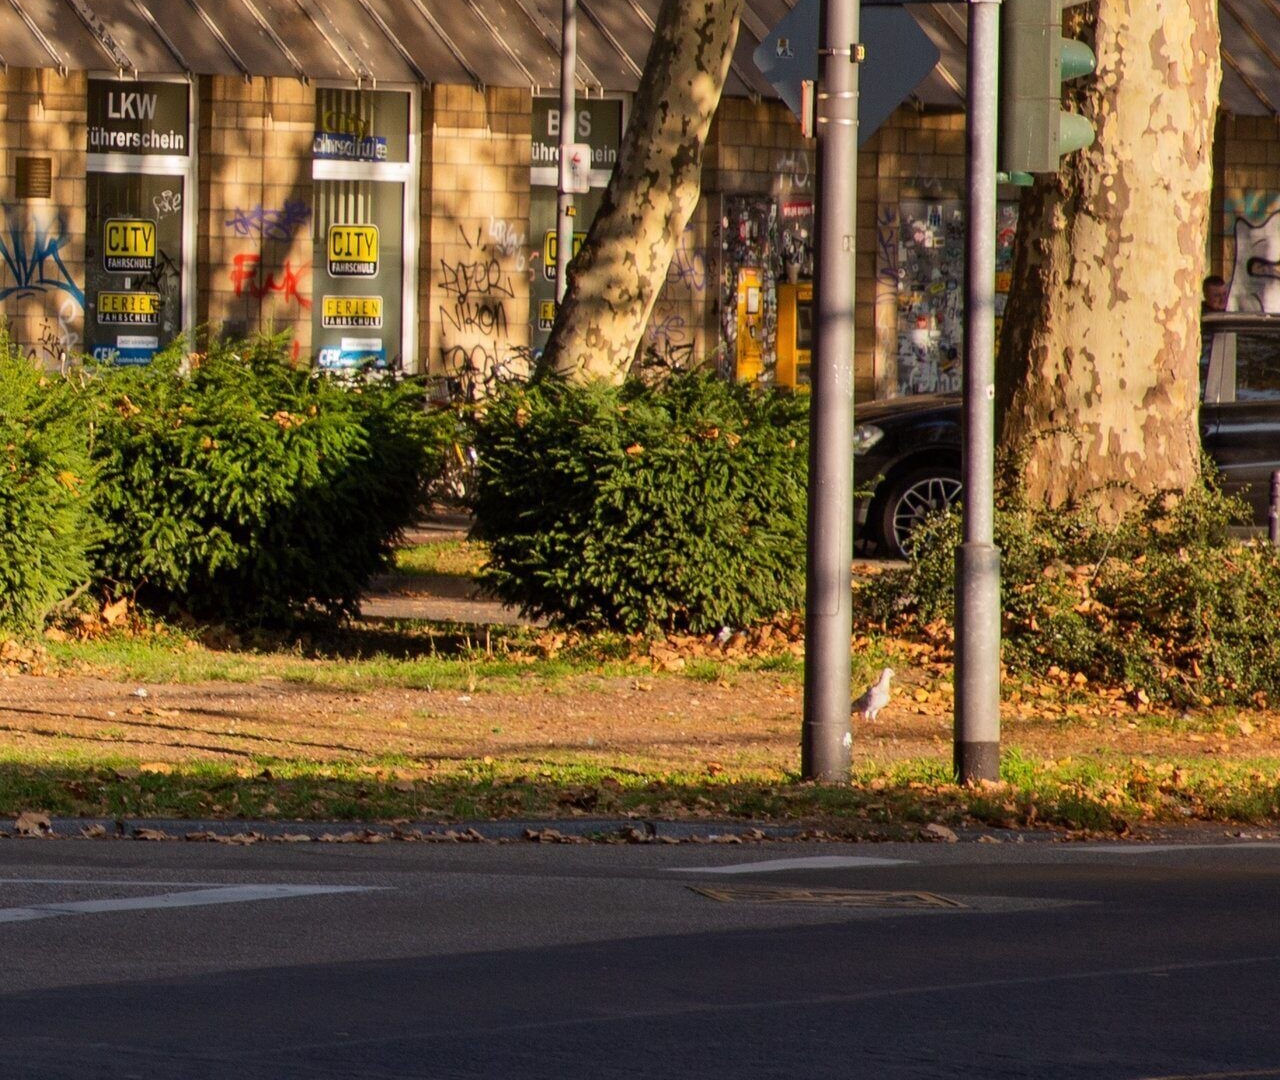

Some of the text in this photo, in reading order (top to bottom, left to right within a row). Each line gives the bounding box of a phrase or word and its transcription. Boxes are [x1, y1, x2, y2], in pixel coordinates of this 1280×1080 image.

[108, 92, 158, 120] LKW
[548, 109, 592, 137] BS
[88, 126, 184, 150] ührerschein
[313, 133, 388, 159] ahrschule
[109, 226, 153, 252] CITY
[332, 231, 375, 257] CITY
[107, 257, 153, 269] FAHRSCHULE
[331, 262, 375, 274] FAHRSCHULE
[327, 301, 379, 314] FERIEN
[325, 317, 380, 326] FAHRSCHULE
